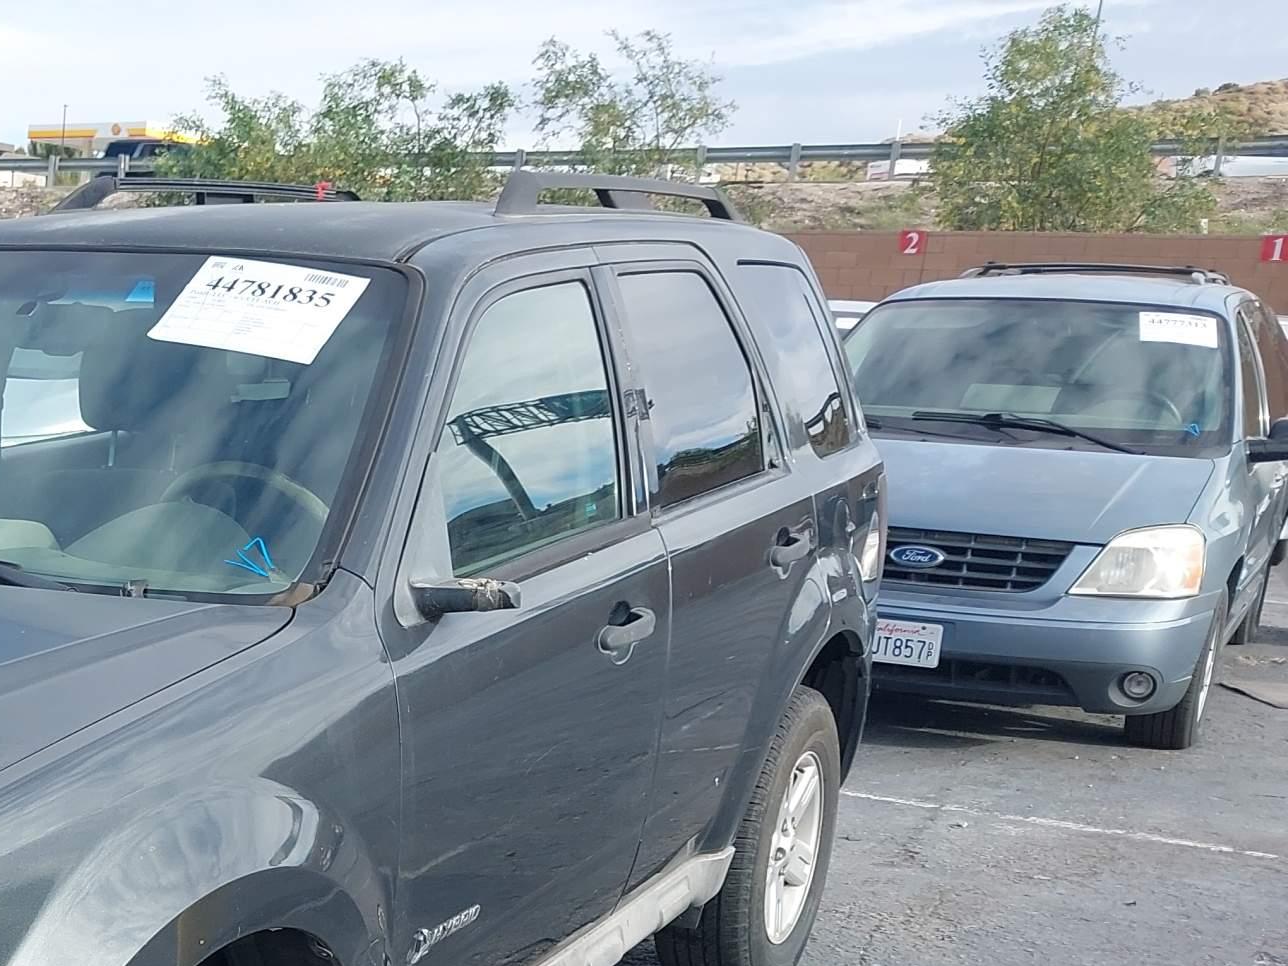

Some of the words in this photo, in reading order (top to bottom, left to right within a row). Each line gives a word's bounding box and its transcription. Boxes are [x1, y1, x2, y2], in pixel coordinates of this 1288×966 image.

[903, 232, 920, 254] 2
[1271, 237, 1284, 261] 1
[206, 275, 336, 308] 44781835
[902, 549, 932, 562] Ford
[875, 623, 920, 635] alifornia
